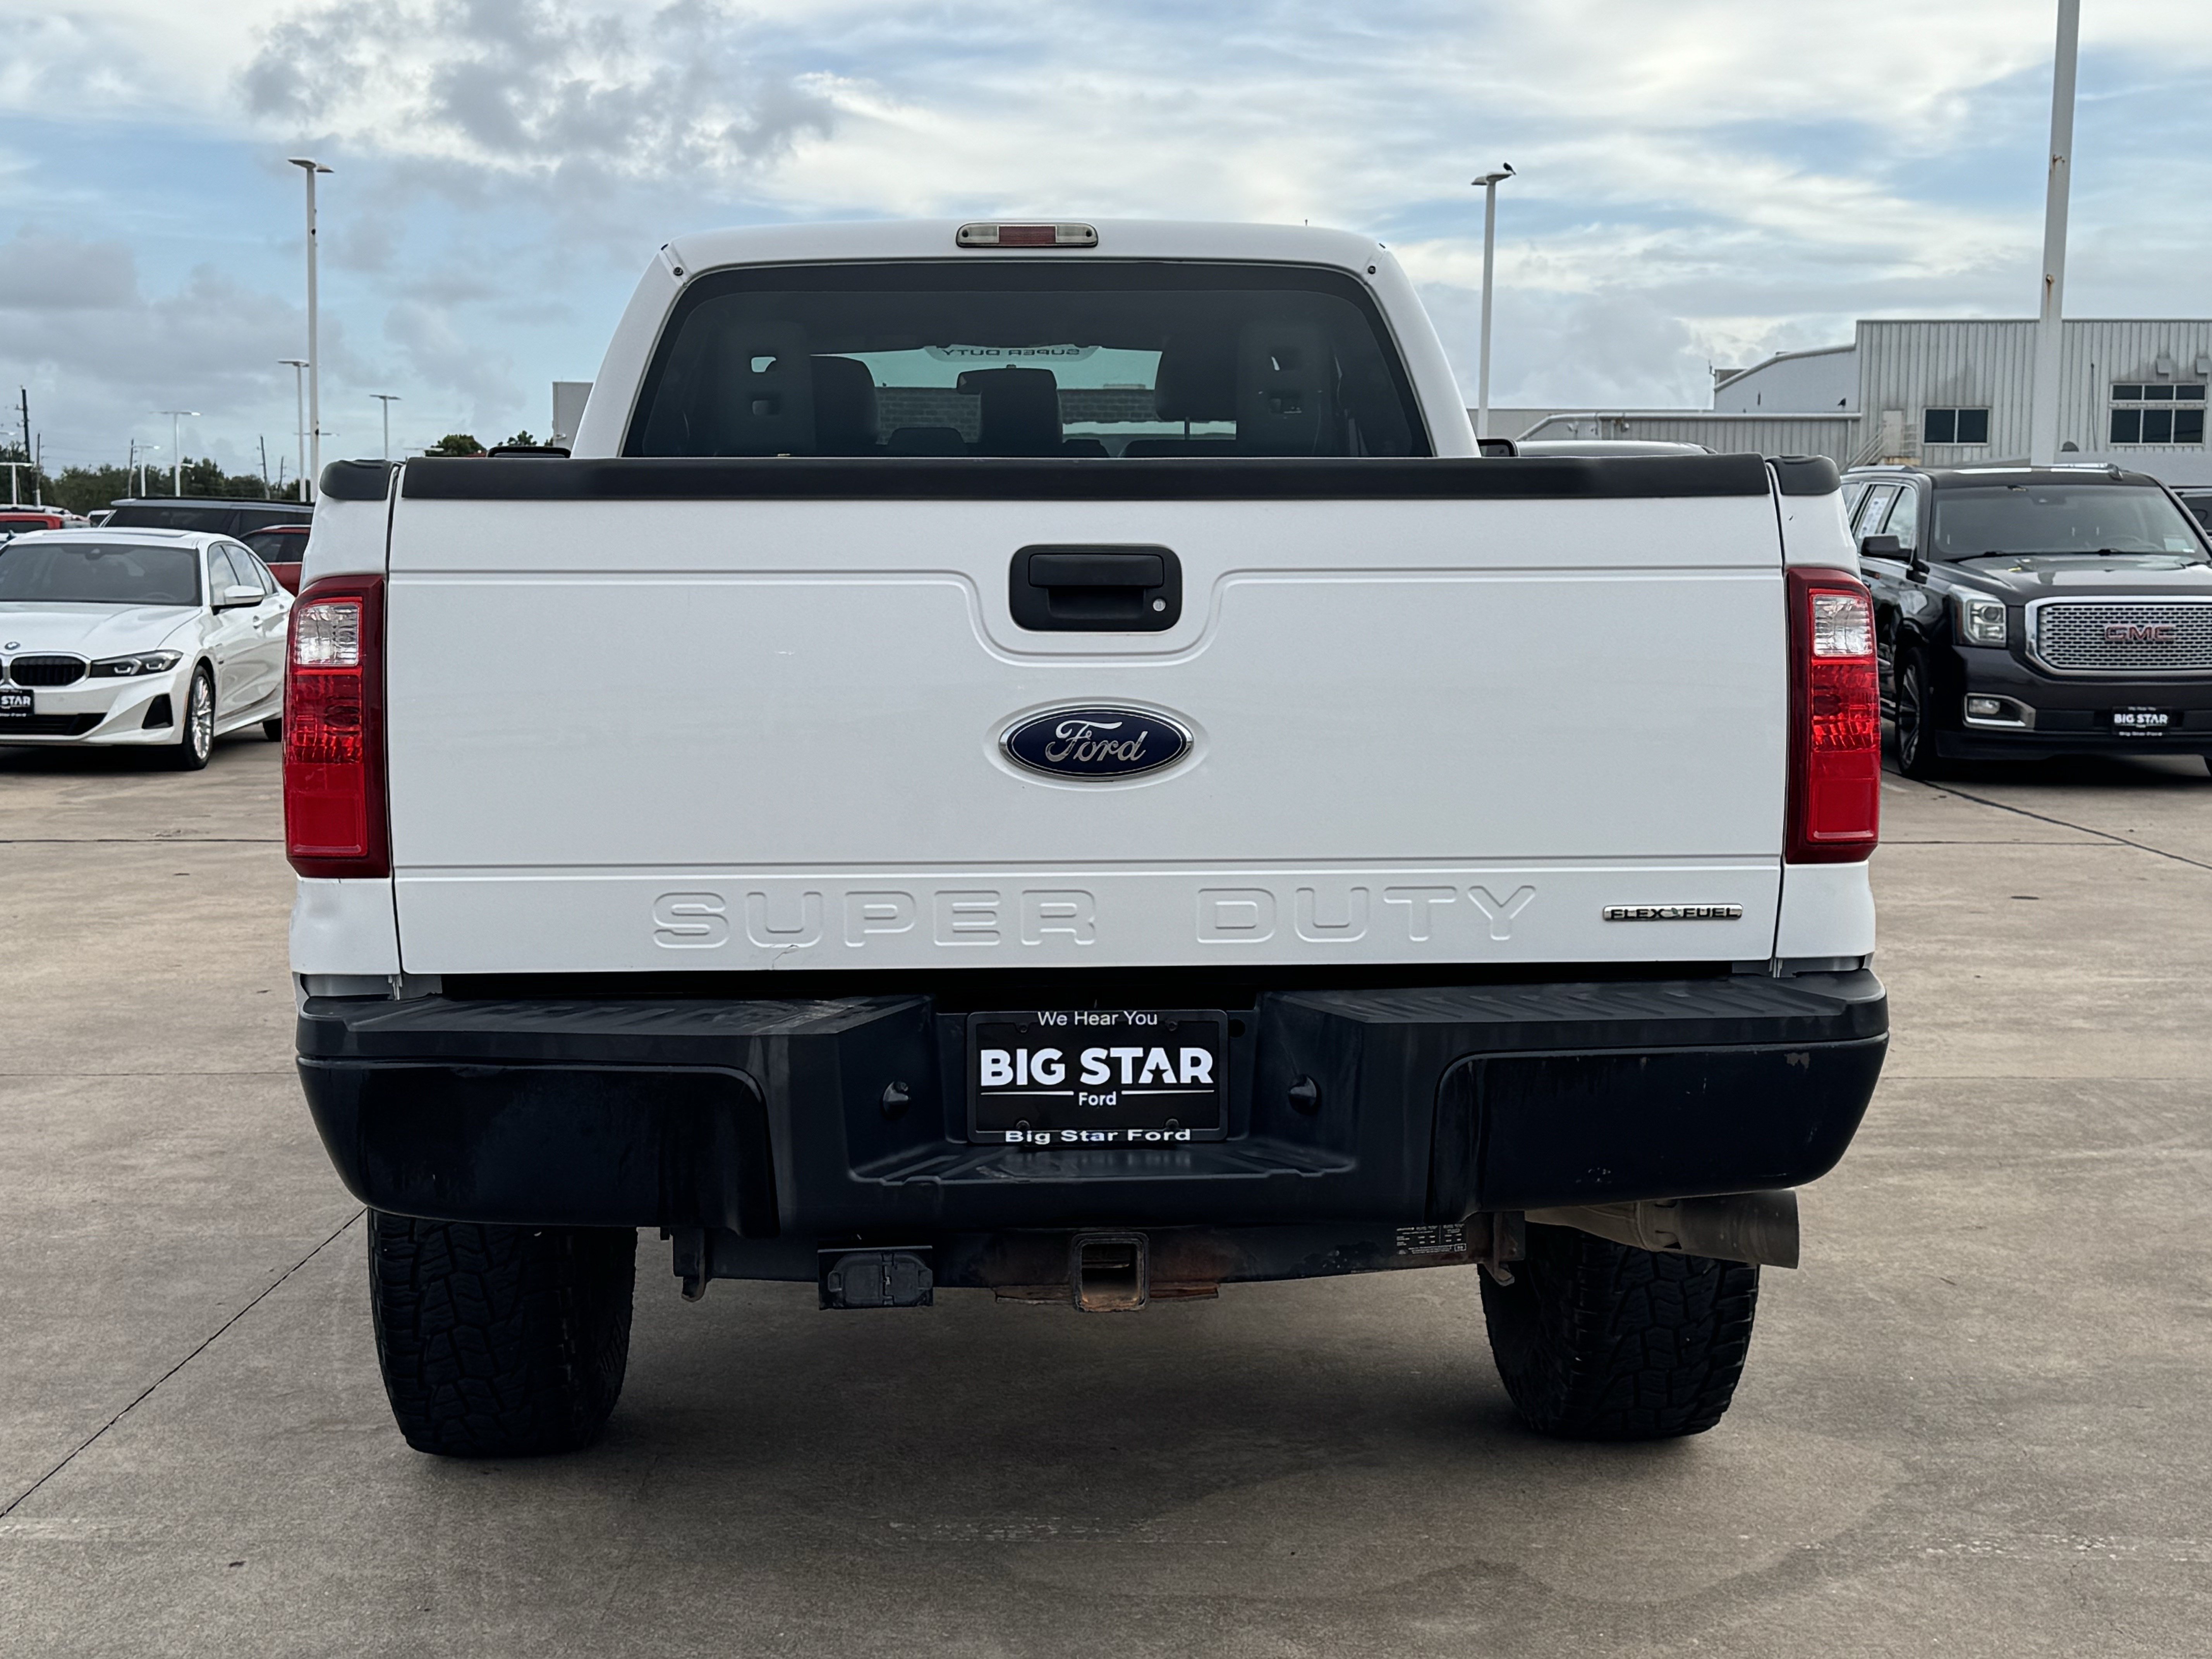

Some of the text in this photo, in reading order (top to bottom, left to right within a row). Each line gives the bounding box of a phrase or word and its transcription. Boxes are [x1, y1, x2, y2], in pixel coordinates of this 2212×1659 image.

[2104, 624, 2176, 641] GMC
[1, 695, 31, 705] STAR
[2114, 713, 2169, 724] BIG STAR
[1046, 720, 1148, 762] Ford
[653, 885, 1536, 948] SUPER DUTY
[1610, 907, 1738, 919] FLEX FUEL
[1037, 1010, 1158, 1026] We Hear You
[980, 1047, 1214, 1086] BIG STAR
[1079, 1091, 1117, 1106] Ford
[1005, 1129, 1191, 1145] Big Star Ford
